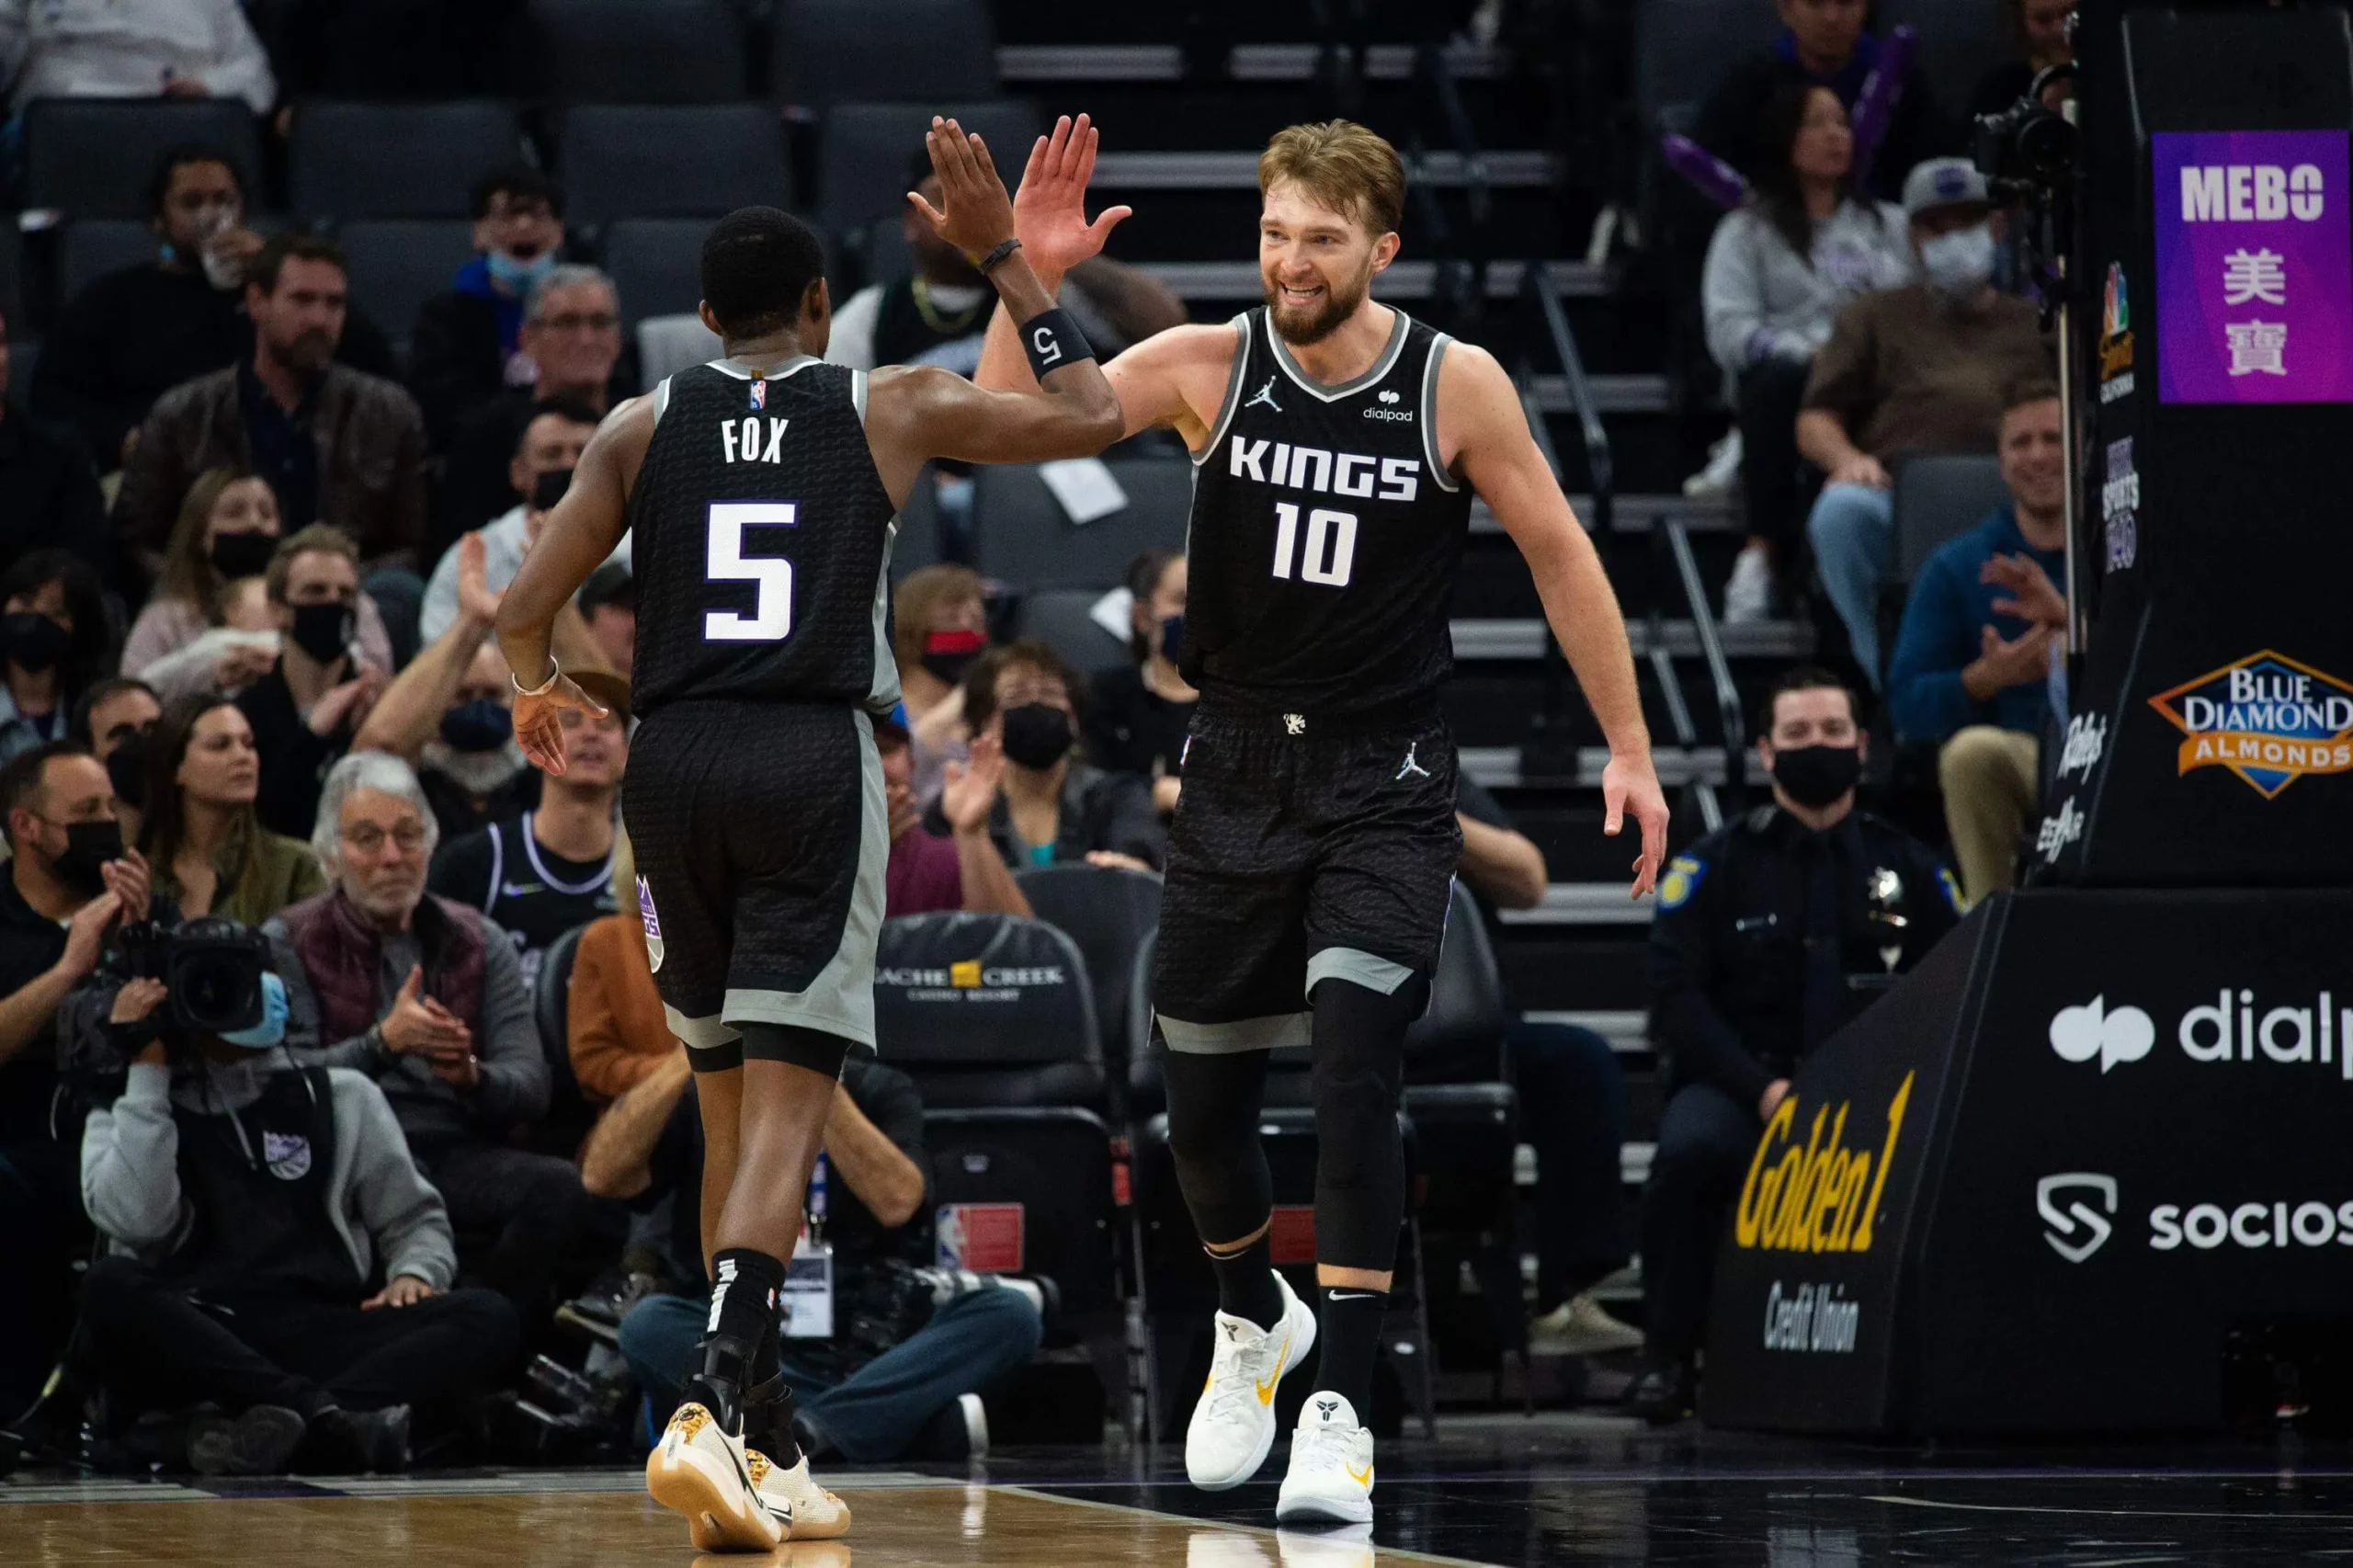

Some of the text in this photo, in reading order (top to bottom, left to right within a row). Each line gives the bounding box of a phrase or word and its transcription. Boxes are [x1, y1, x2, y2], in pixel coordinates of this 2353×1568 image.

[2179, 164, 2325, 222] MEBO
[2223, 247, 2288, 376] 美寶
[1033, 326, 1063, 366] 5
[722, 416, 789, 464] FOX
[1363, 407, 1413, 422] dialpad
[1229, 435, 1420, 502] KINGS
[1272, 502, 1358, 587] 10
[703, 501, 798, 642] 5
[2231, 668, 2313, 704] BLUE
[2185, 696, 2353, 732] DIAMOND
[2195, 737, 2351, 767] ALMONDS
[1735, 1094, 1872, 1254] Golden
